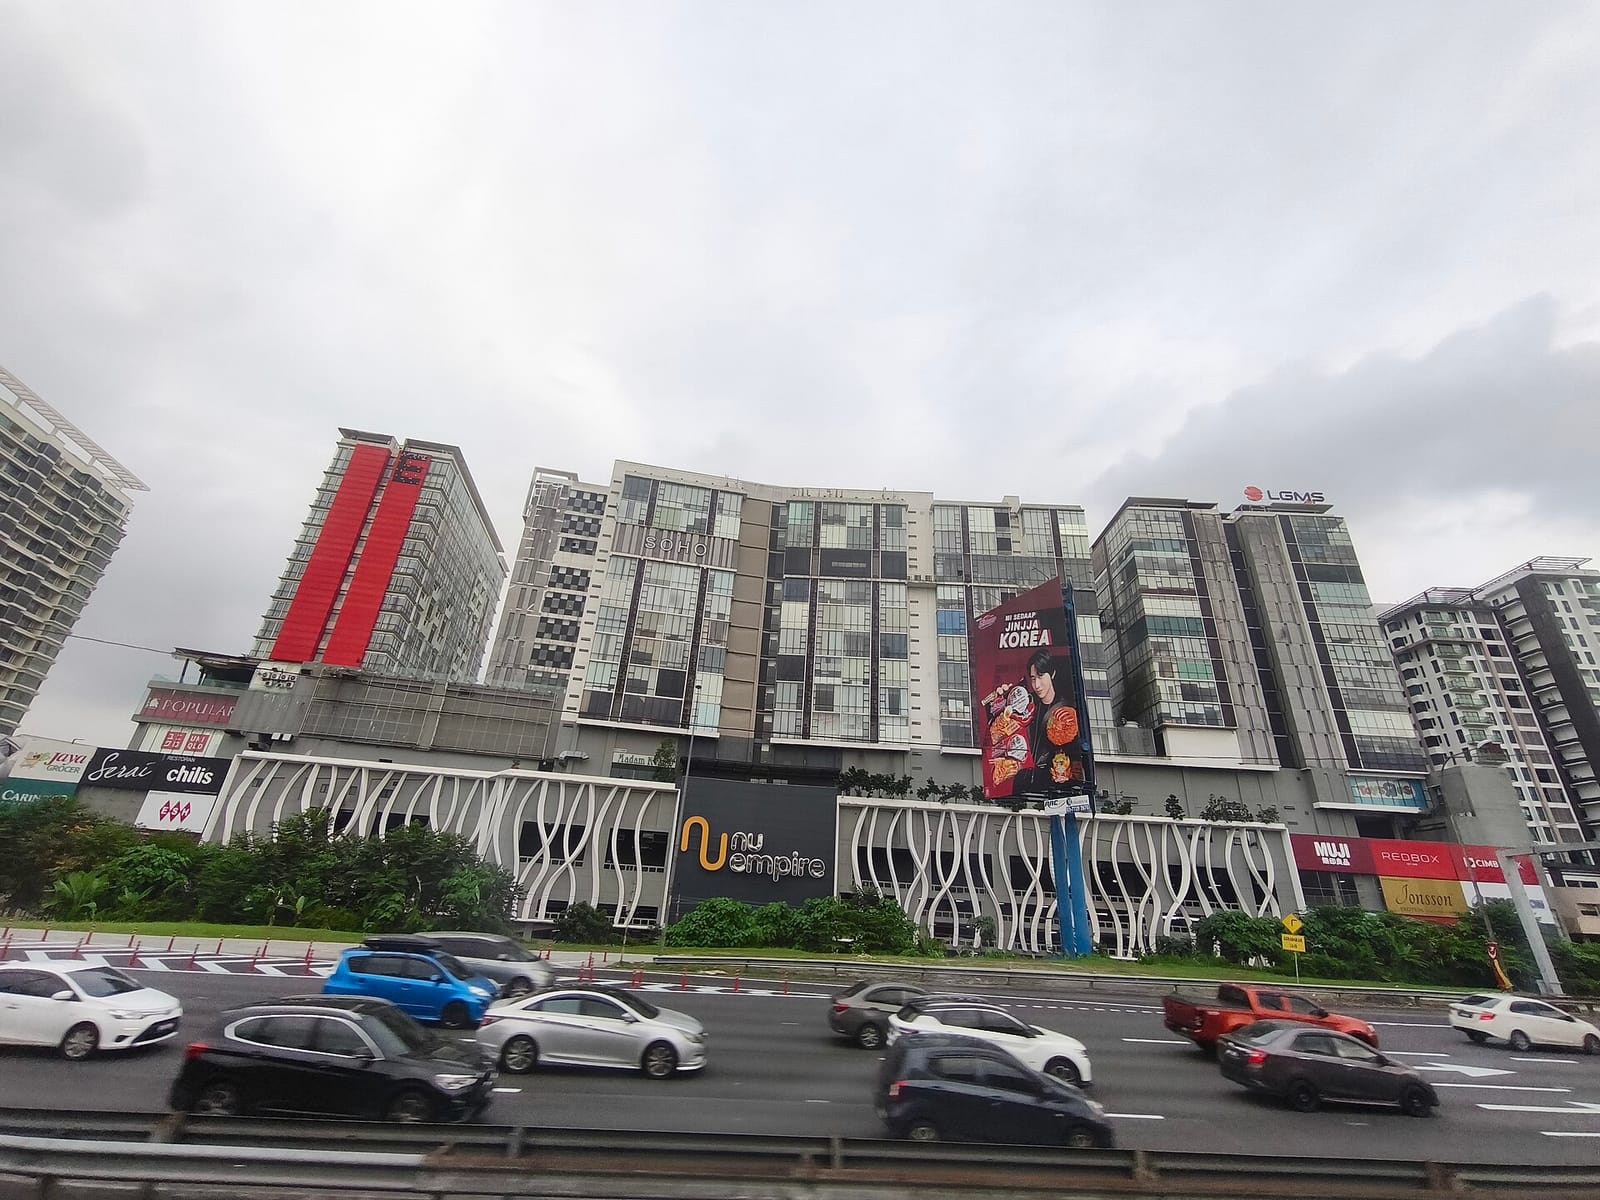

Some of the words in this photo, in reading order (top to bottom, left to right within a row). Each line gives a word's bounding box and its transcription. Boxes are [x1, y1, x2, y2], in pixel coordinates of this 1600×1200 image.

[1267, 490, 1325, 502] LGMS
[644, 536, 707, 557] SOHO
[1013, 612, 1037, 620] SEDAAP
[1005, 620, 1039, 632] JINJJA
[999, 629, 1050, 649] KOREA
[44, 752, 87, 765] Jaya
[46, 765, 81, 773] GROCER
[88, 752, 157, 781] Serai
[730, 831, 764, 851] nu
[1313, 841, 1351, 859] MUJI
[1381, 851, 1440, 863] REDBOX
[729, 851, 826, 882] empire
[1476, 859, 1499, 868] CIMB
[1395, 884, 1453, 907] Jonsson
